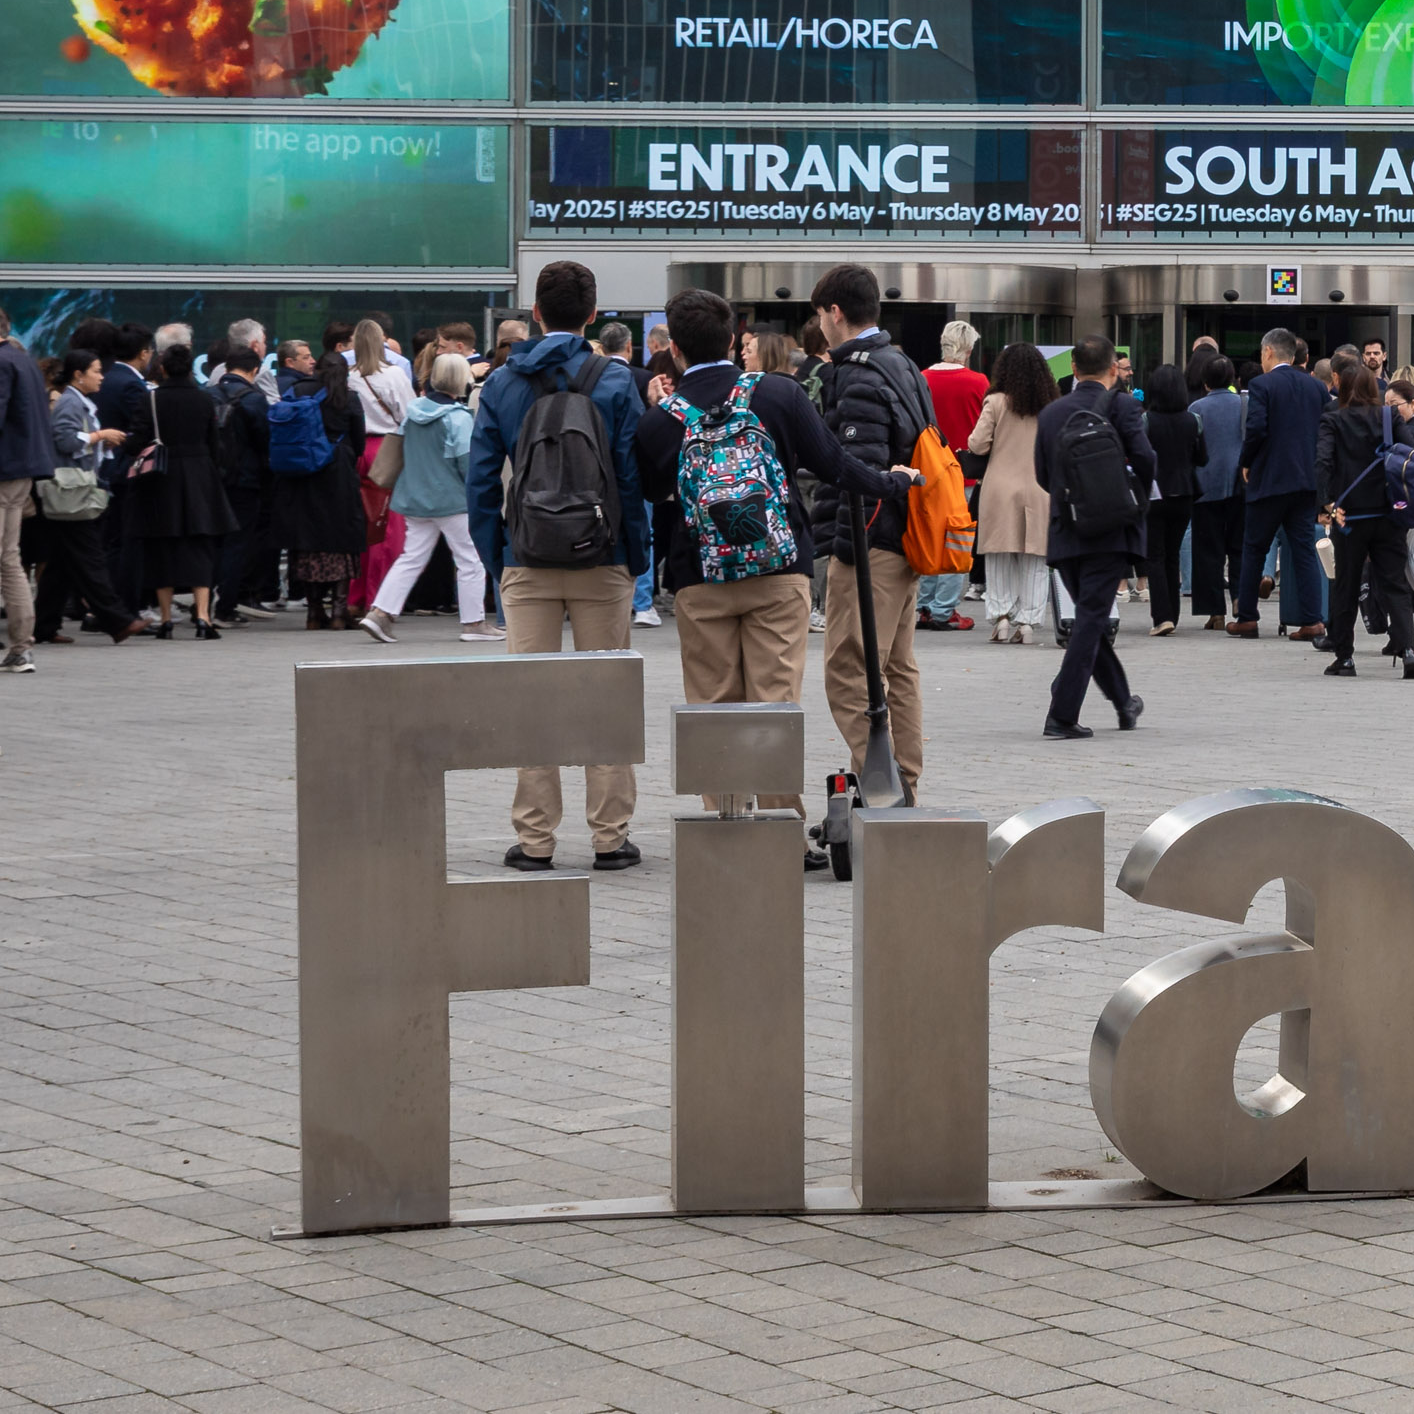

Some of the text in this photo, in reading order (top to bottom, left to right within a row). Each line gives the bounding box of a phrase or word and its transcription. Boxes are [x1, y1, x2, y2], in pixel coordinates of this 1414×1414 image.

[675, 17, 938, 51] RETAIL/HORECA
[255, 125, 441, 160] the app now!
[649, 143, 949, 193] ENTRANCE
[1165, 146, 1357, 196] SOUTH
[564, 200, 617, 219] 2025
[628, 201, 710, 219] #SEG25
[721, 201, 809, 224] Tuesday
[813, 202, 827, 220] 6
[830, 202, 874, 225] May
[889, 202, 984, 226] Thursday
[987, 202, 1002, 222] 8
[1005, 203, 1049, 226] May
[1052, 203, 1082, 222] 20
[1116, 203, 1198, 222] #SEG25
[1208, 204, 1296, 227] Tuesday
[1299, 204, 1312, 223] 6
[1316, 205, 1359, 227] May
